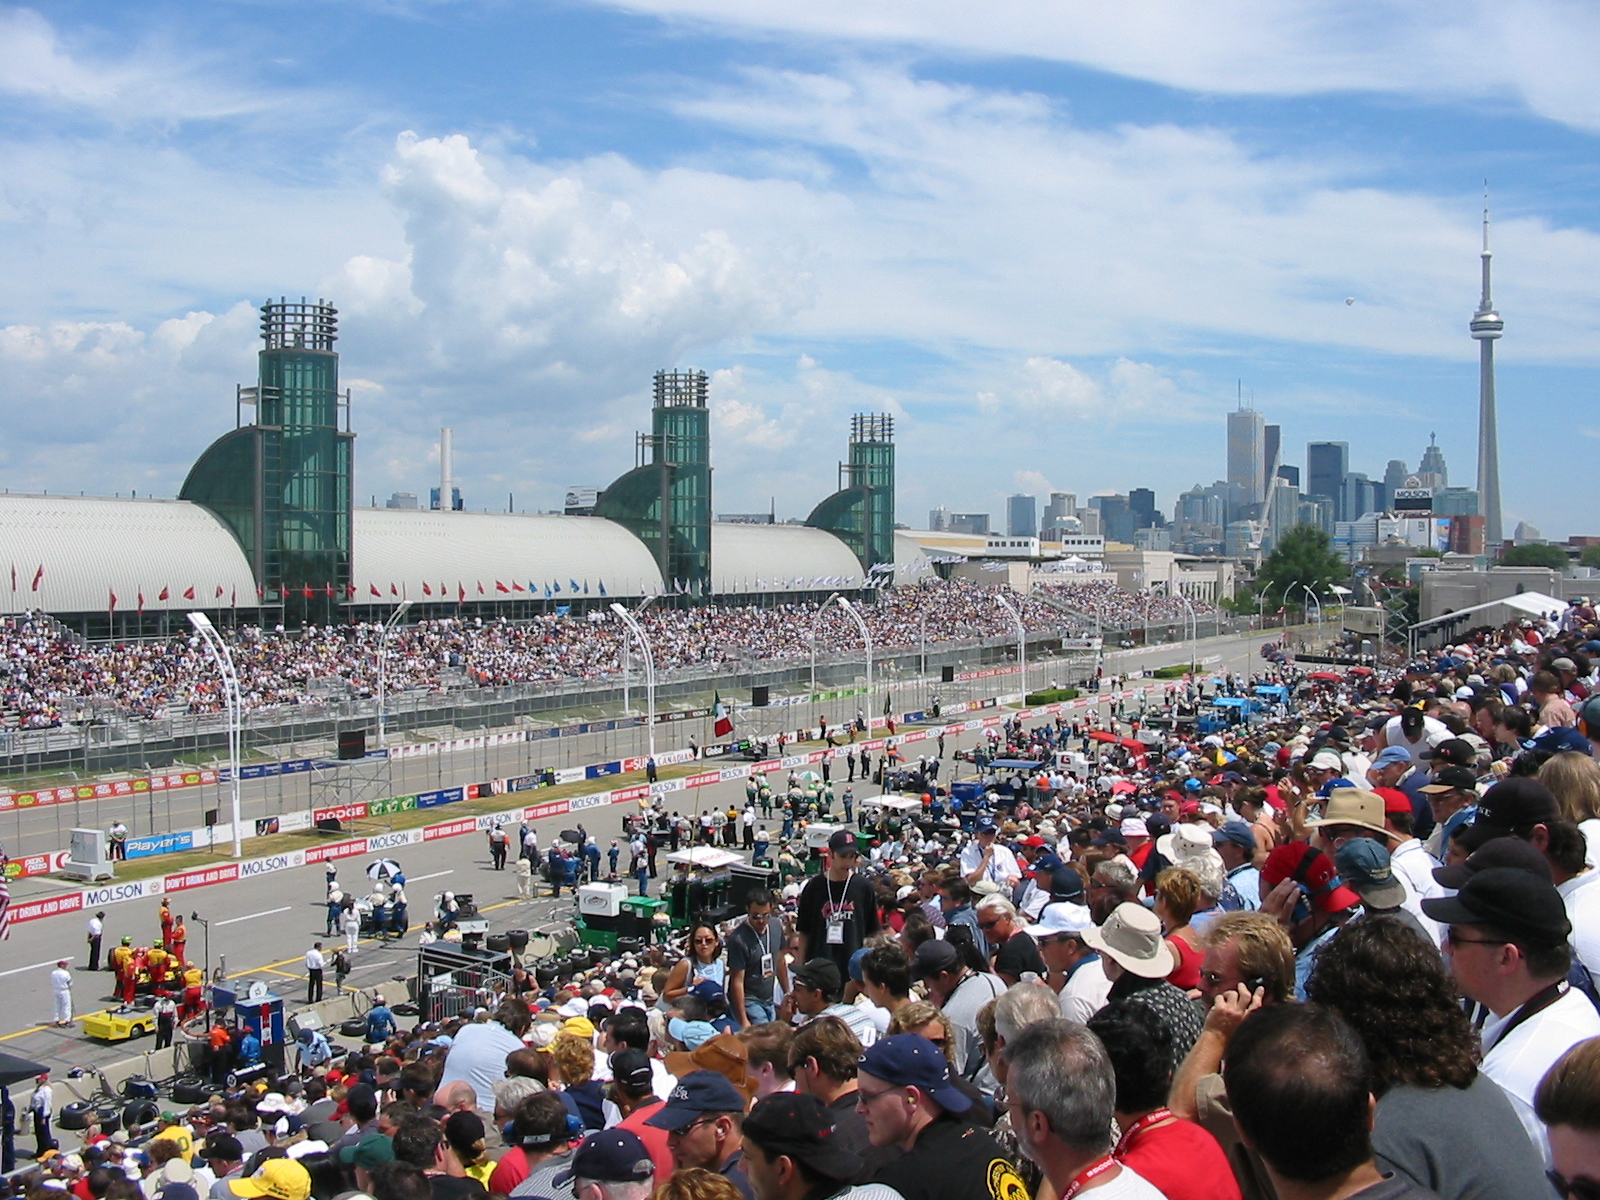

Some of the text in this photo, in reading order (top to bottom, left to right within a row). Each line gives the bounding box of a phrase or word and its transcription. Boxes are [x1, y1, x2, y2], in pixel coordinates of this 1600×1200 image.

[1397, 490, 1430, 498] MOLSON
[570, 795, 600, 810] MOLSON
[316, 806, 365, 820] DODGE
[478, 812, 512, 828] MOLSON
[424, 820, 475, 839] DON'T DRINK AND DRIVE
[127, 834, 191, 854] Player's
[369, 832, 409, 850] MOLSON
[306, 840, 366, 862] DON'T DRINK AND DRIVE
[241, 855, 288, 876] MOLSON
[166, 867, 237, 890] DON'T DRINK AND DRIVE
[86, 883, 142, 906] MOLSON
[19, 905, 42, 919] DRINK
[42, 901, 58, 915] AND
[59, 896, 80, 911] DRIVE
